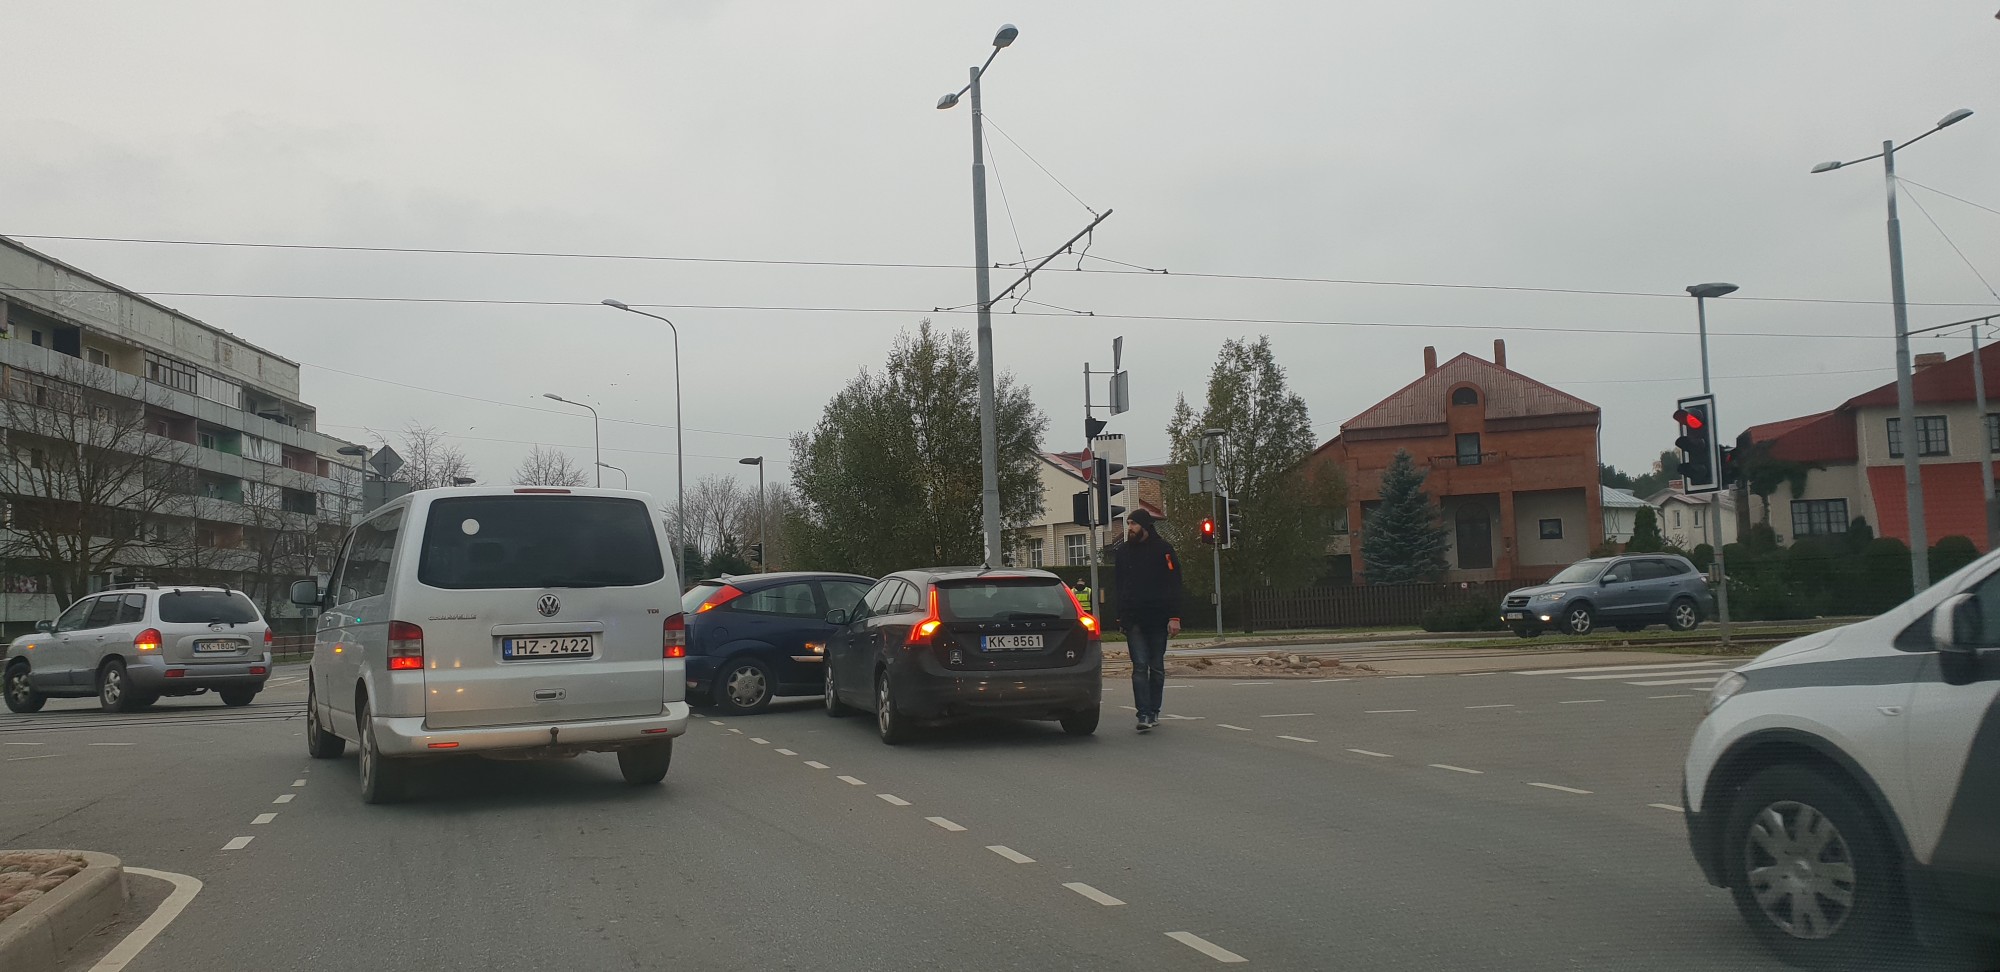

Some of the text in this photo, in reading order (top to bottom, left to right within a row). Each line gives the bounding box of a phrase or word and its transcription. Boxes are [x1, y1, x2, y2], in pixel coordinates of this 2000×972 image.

[200, 642, 235, 651] KK-1804
[516, 638, 590, 655] HZ-2422
[988, 635, 1042, 648] KK-8561
